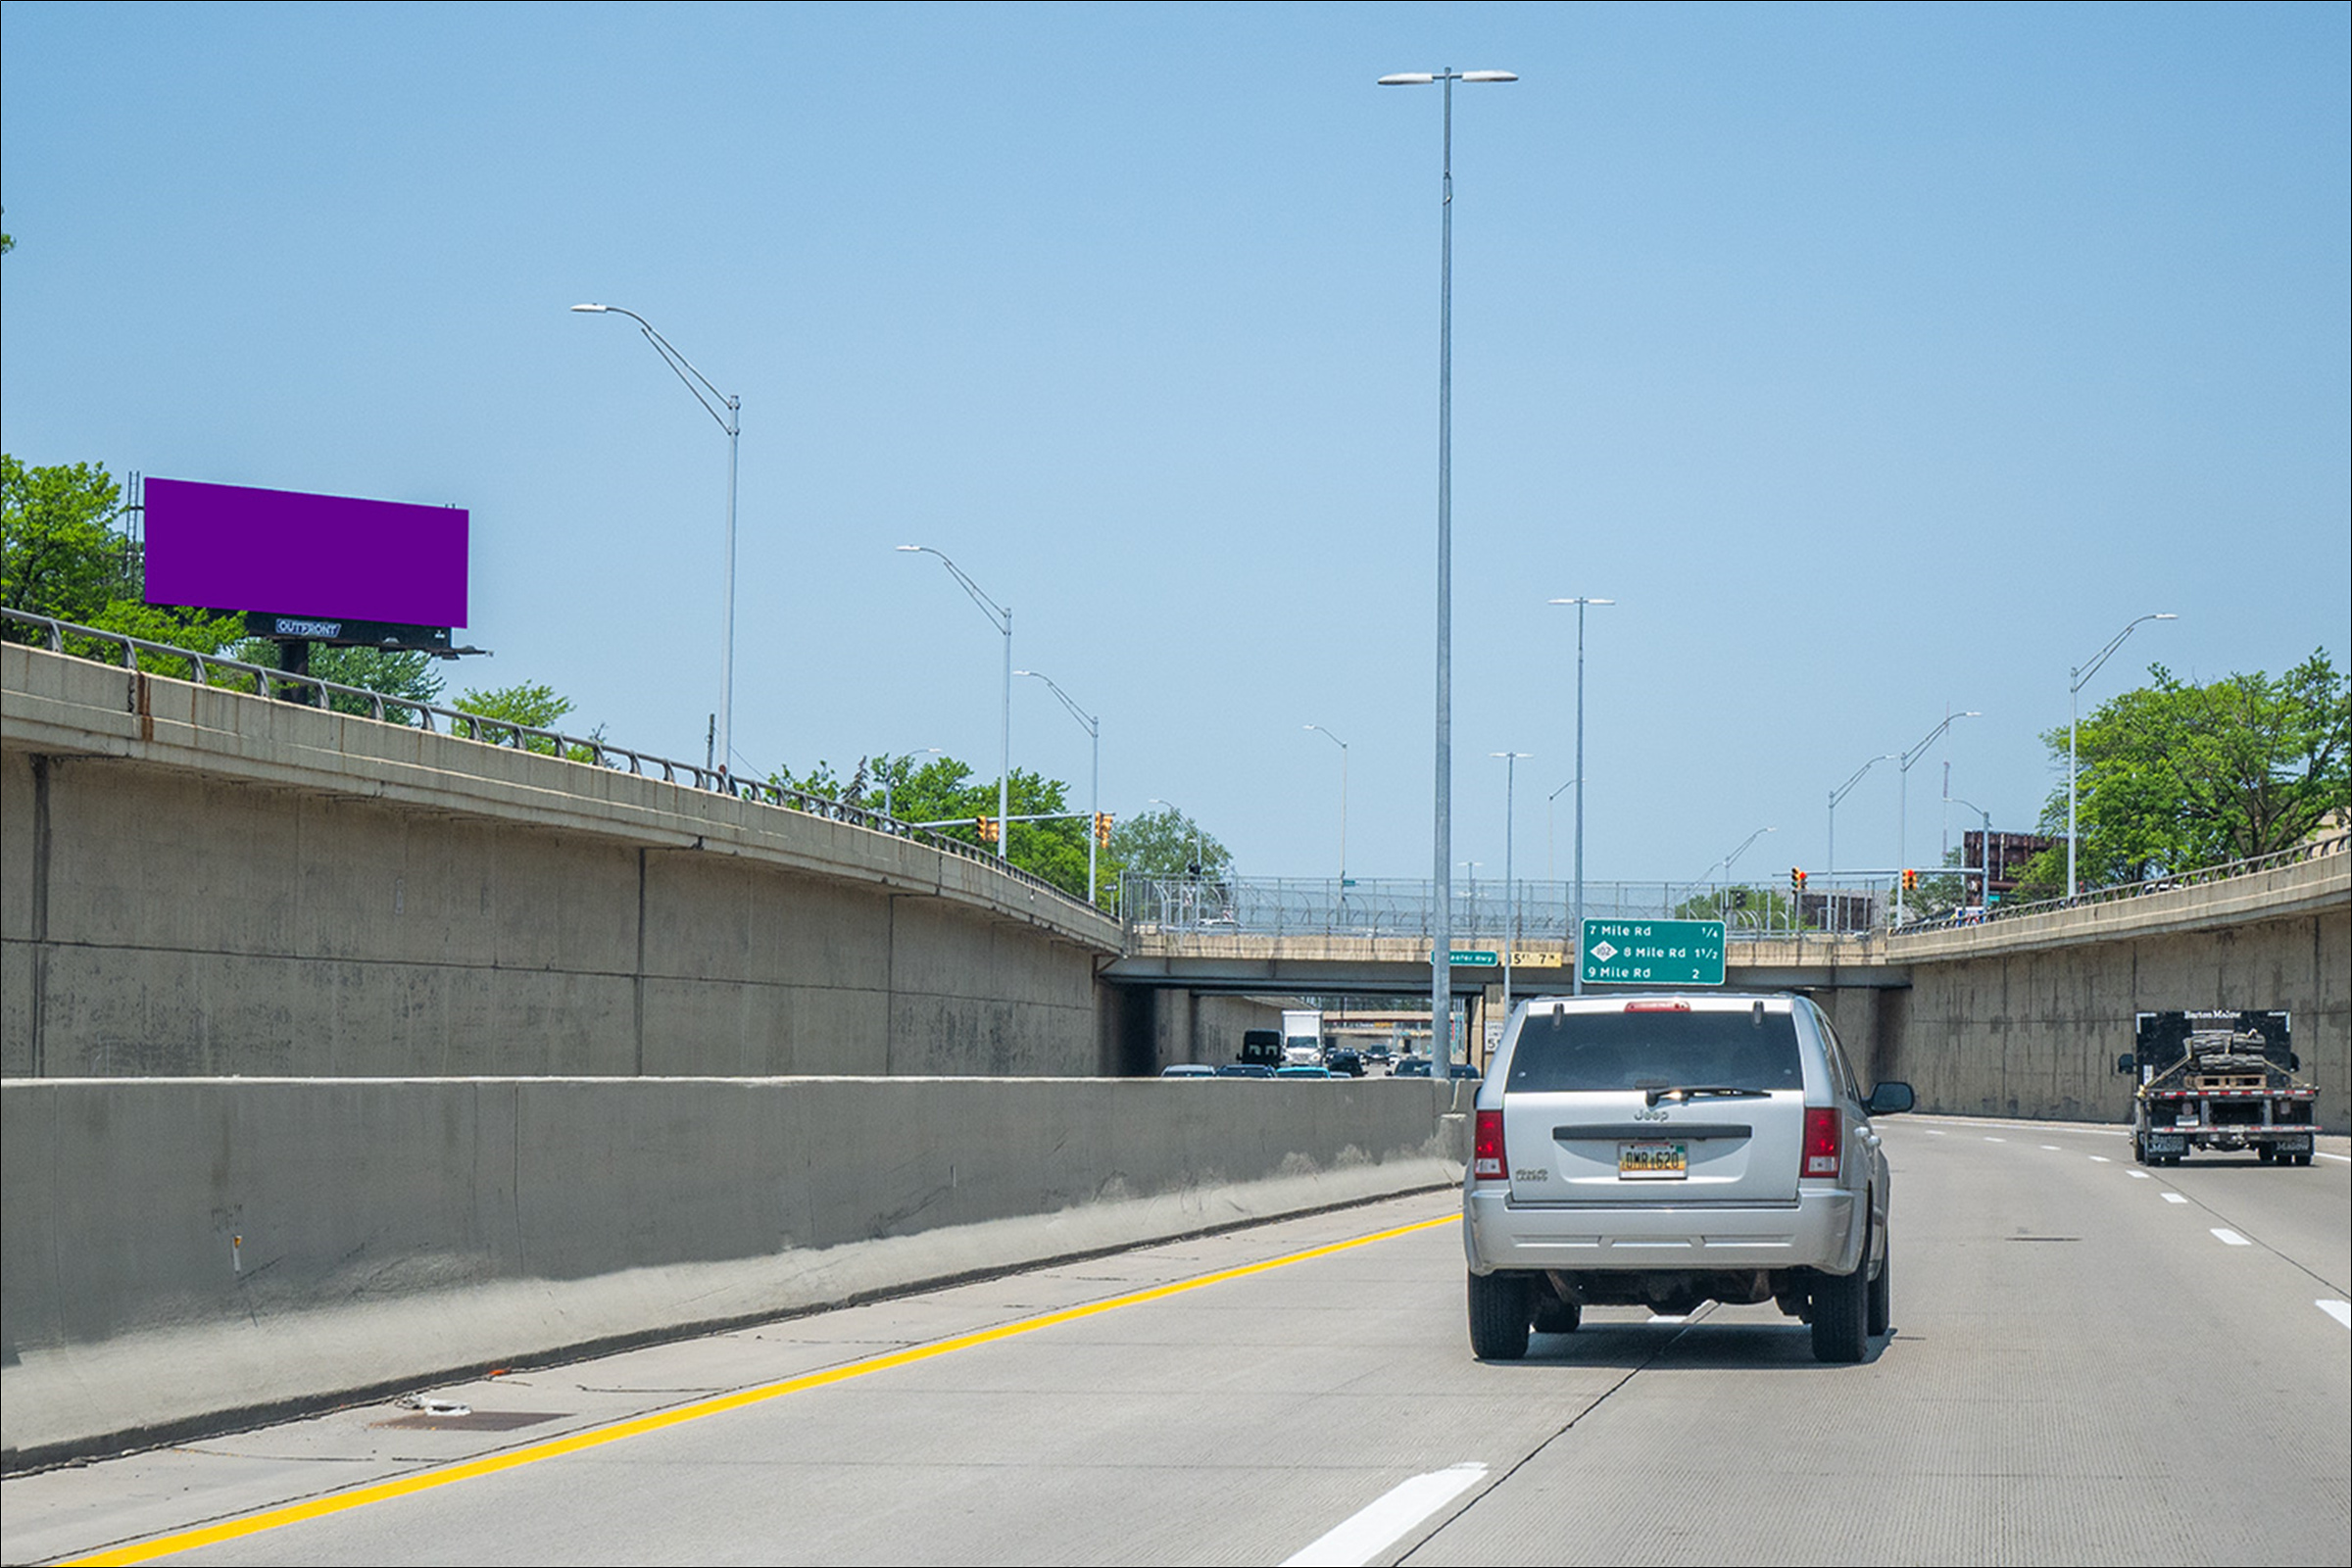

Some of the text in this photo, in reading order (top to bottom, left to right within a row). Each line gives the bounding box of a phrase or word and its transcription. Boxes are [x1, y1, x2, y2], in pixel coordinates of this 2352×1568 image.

[278, 619, 340, 637] OUTFRONT
[1589, 925, 1651, 937] 7 Mile Rd
[1623, 947, 1687, 958] 8 Mile Rd
[1588, 966, 1651, 978] 9 Mile Rd
[1691, 968, 1700, 979] 2
[1634, 1108, 1669, 1123] Jeep
